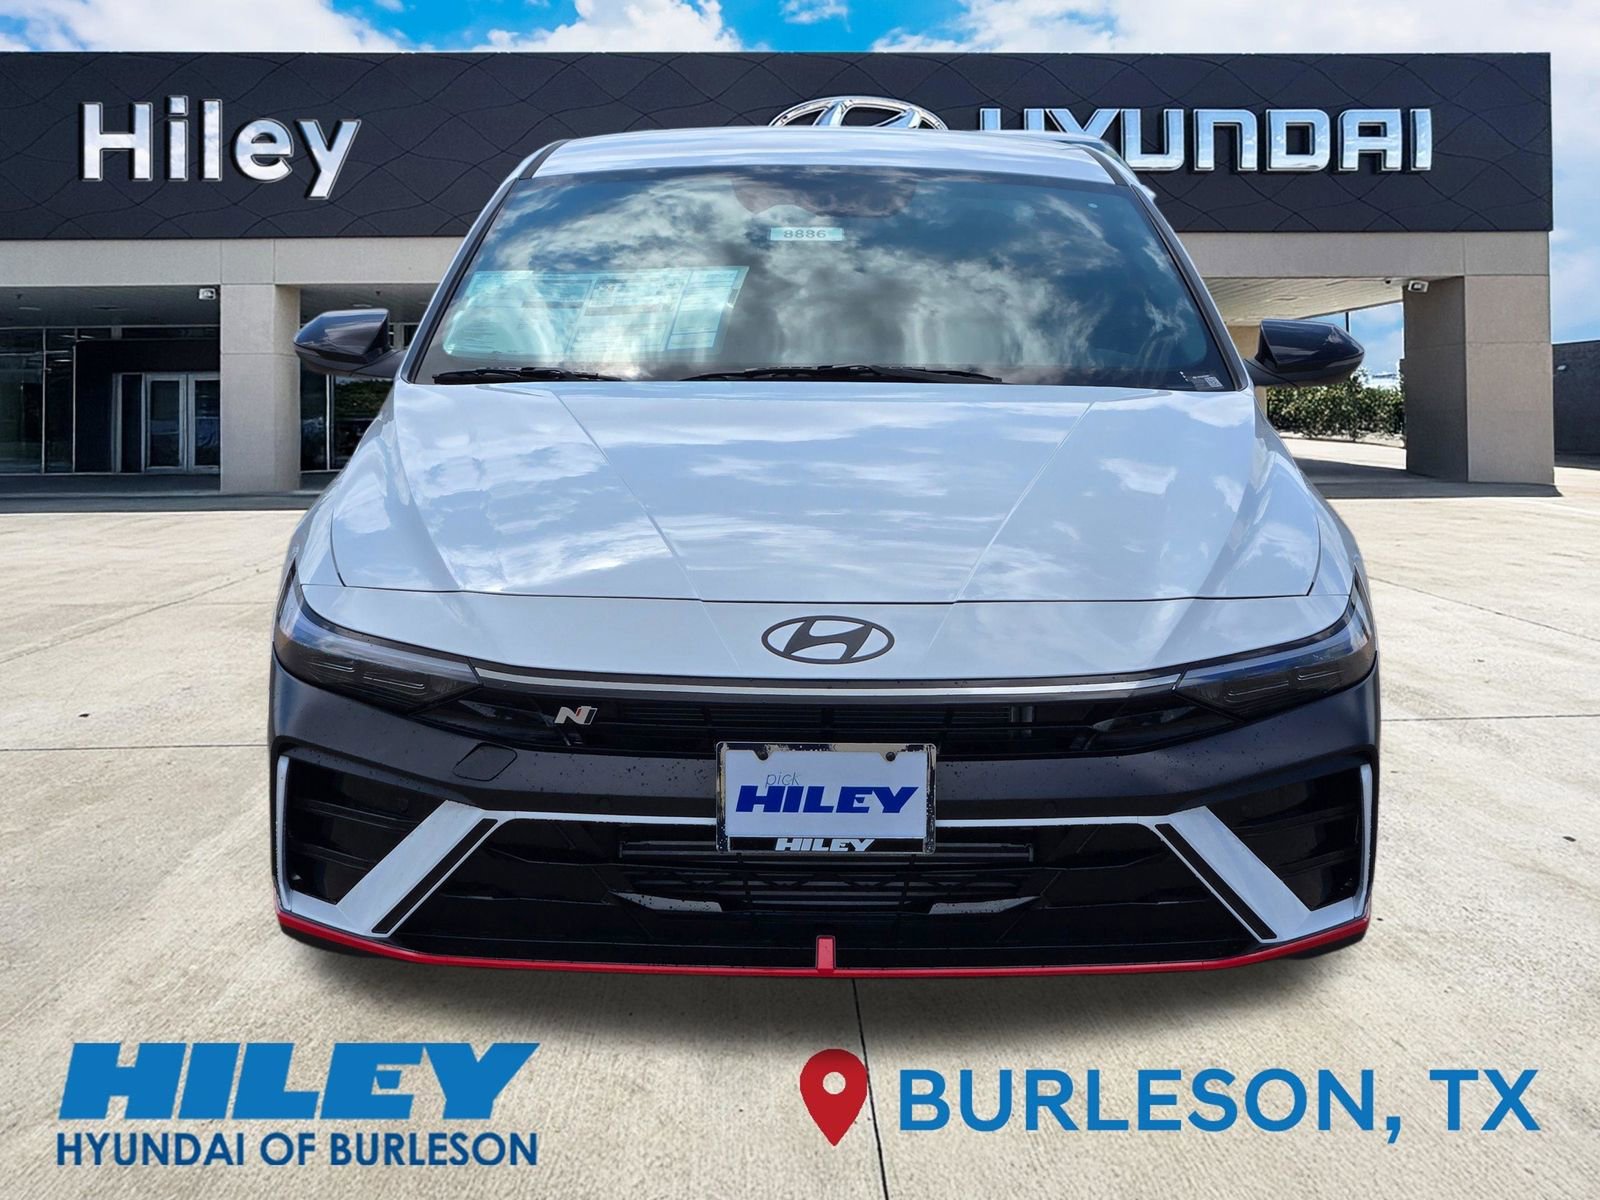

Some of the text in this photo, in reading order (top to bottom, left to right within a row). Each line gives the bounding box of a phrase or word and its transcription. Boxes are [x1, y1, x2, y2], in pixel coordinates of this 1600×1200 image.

[80, 95, 361, 199] Hiley
[783, 229, 827, 239] 8886
[765, 771, 800, 787] pick
[735, 785, 919, 814] HILEY
[775, 838, 875, 852] HILEY
